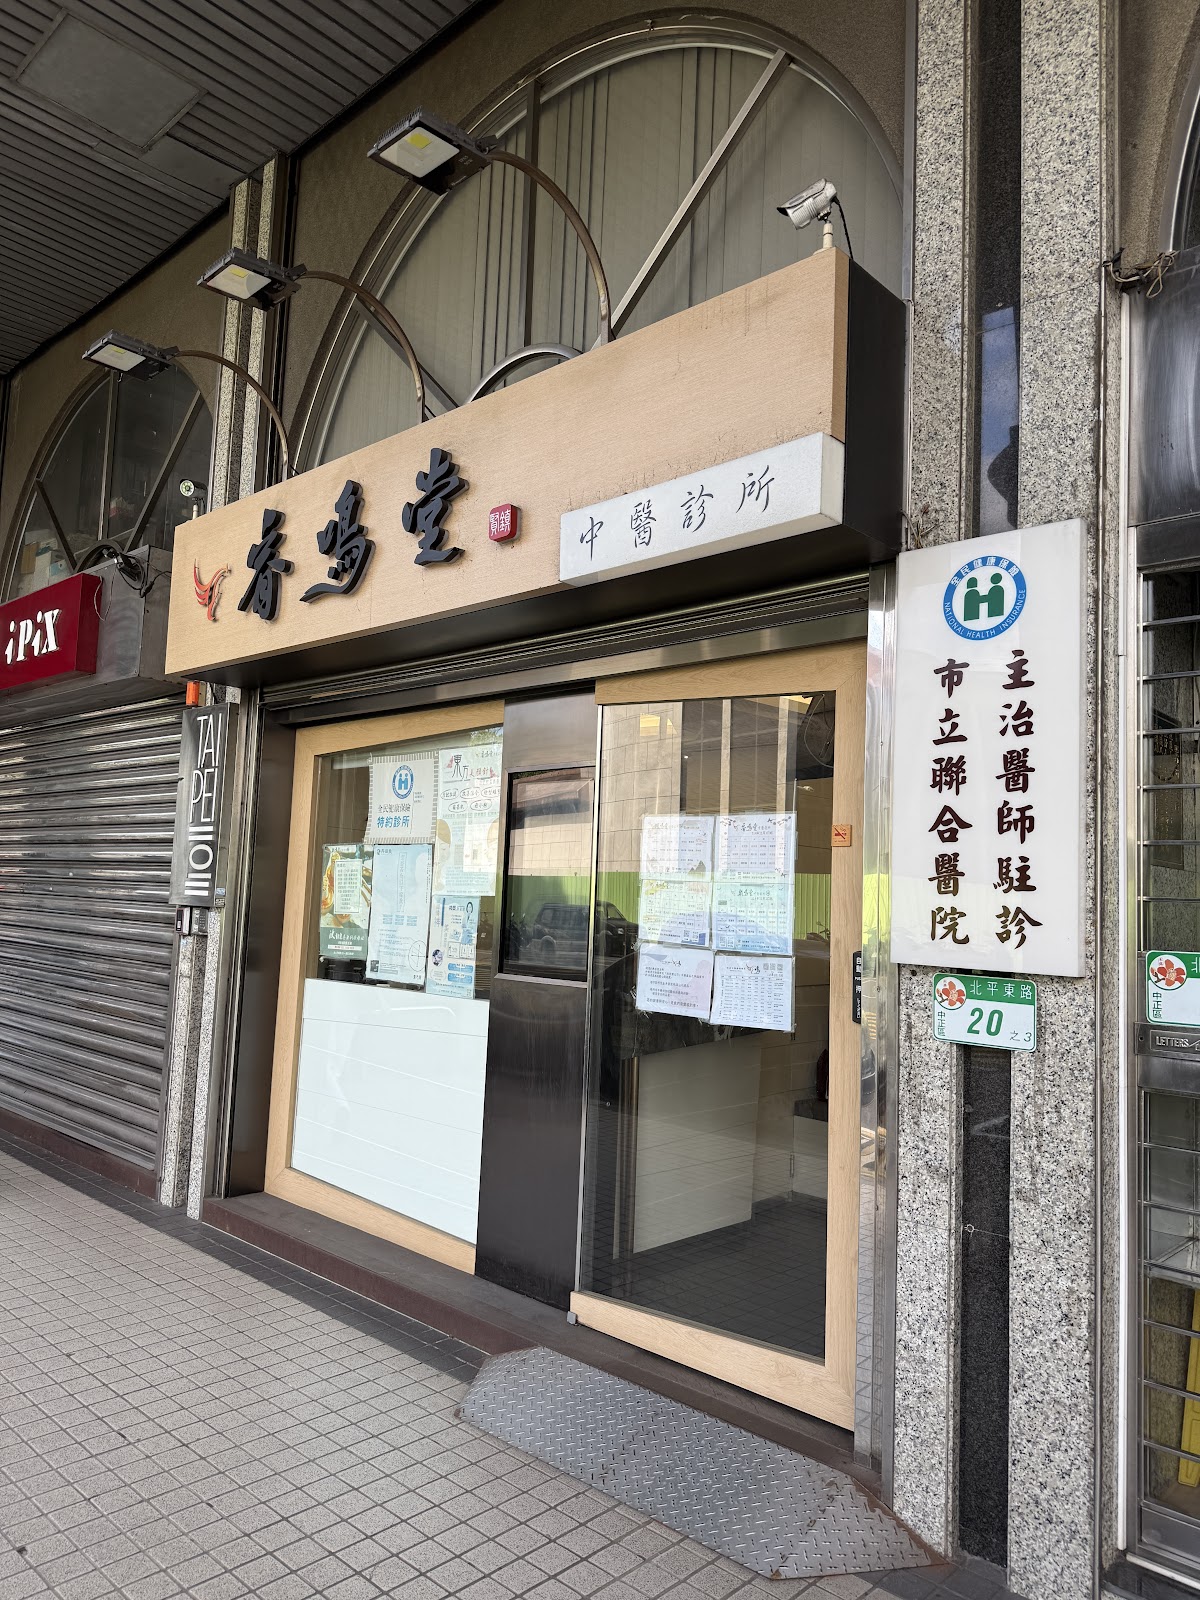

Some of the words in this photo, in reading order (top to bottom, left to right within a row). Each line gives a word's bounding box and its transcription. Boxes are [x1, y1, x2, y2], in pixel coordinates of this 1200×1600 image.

[579, 464, 775, 562] 中醫診所
[950, 556, 1020, 587] 全民健康保險
[944, 601, 964, 634] NATIONAL
[966, 629, 996, 639] HEALTH
[1000, 589, 1026, 631] INSURANCE
[928, 657, 974, 947] 市立聯合醫院
[992, 648, 1043, 951] 主治醫師駐診
[377, 815, 410, 829] 特約診所
[969, 979, 1033, 1000] 北平東路
[1152, 992, 1163, 1019] 中正區
[937, 1010, 946, 1037] 中正區
[966, 1007, 1004, 1037] 20
[1155, 1036, 1189, 1048] LETTERS
